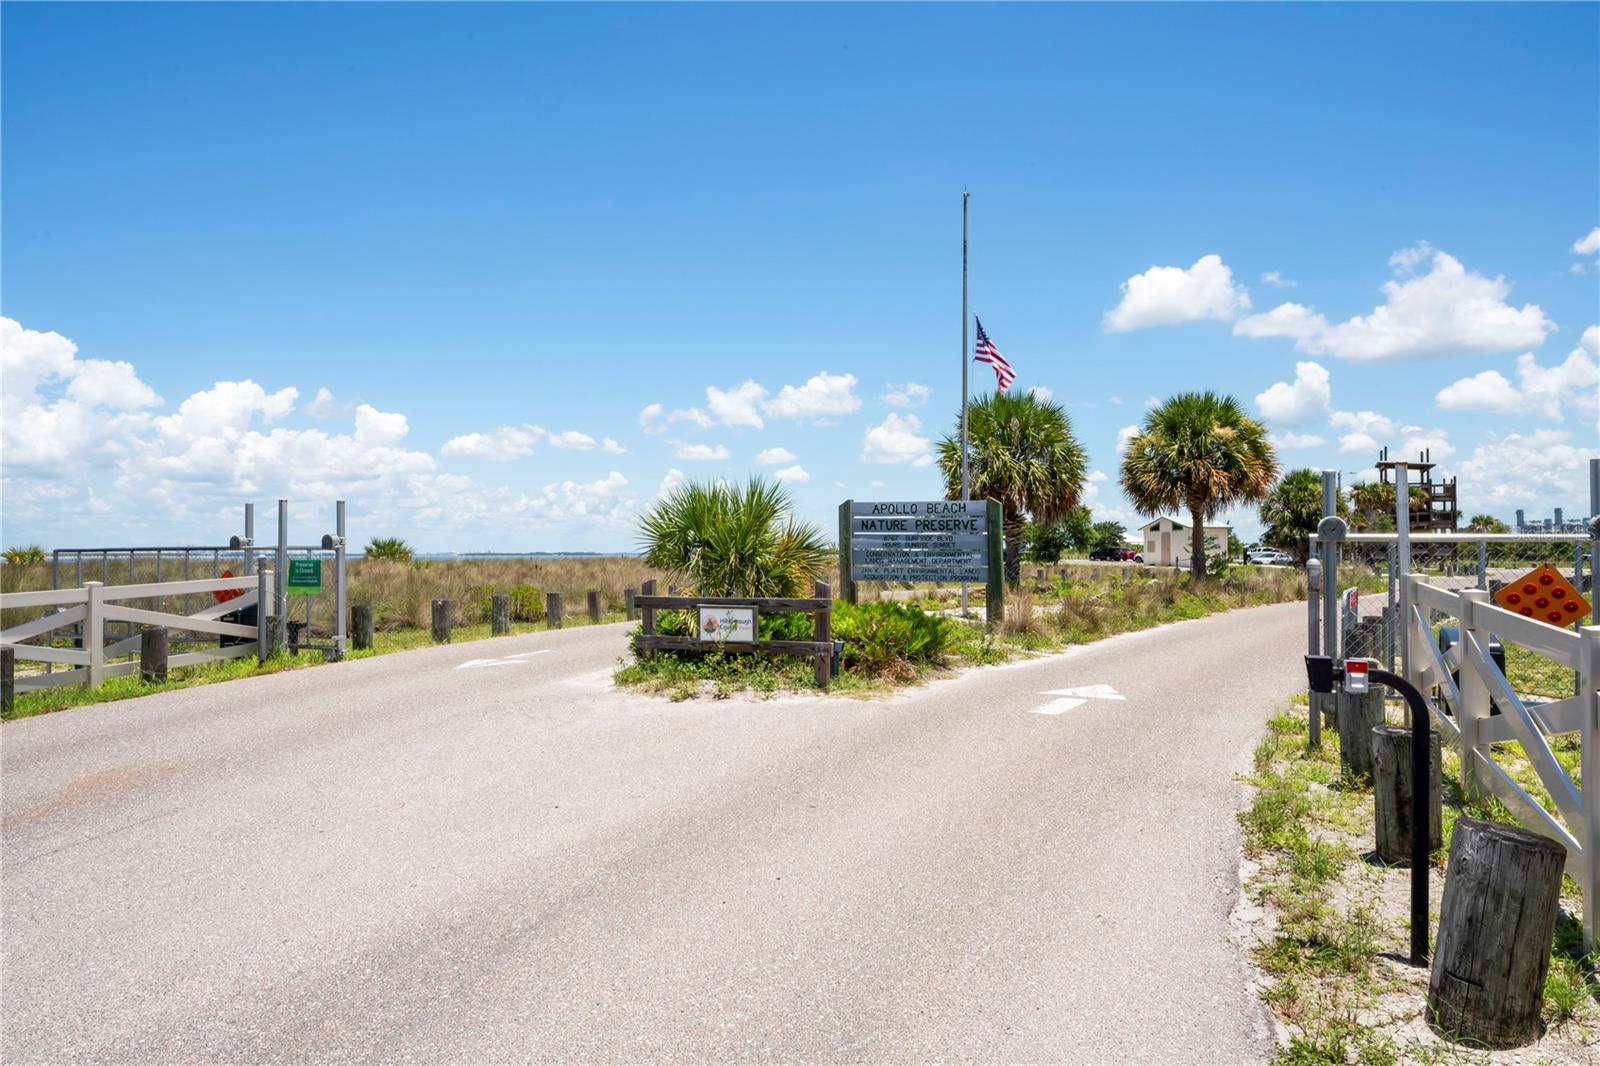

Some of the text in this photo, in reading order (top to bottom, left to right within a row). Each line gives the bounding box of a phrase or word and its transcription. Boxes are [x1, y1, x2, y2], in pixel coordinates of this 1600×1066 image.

[872, 502, 967, 515] APOLLO BEACH
[861, 519, 978, 531] NATURE PRESERVE
